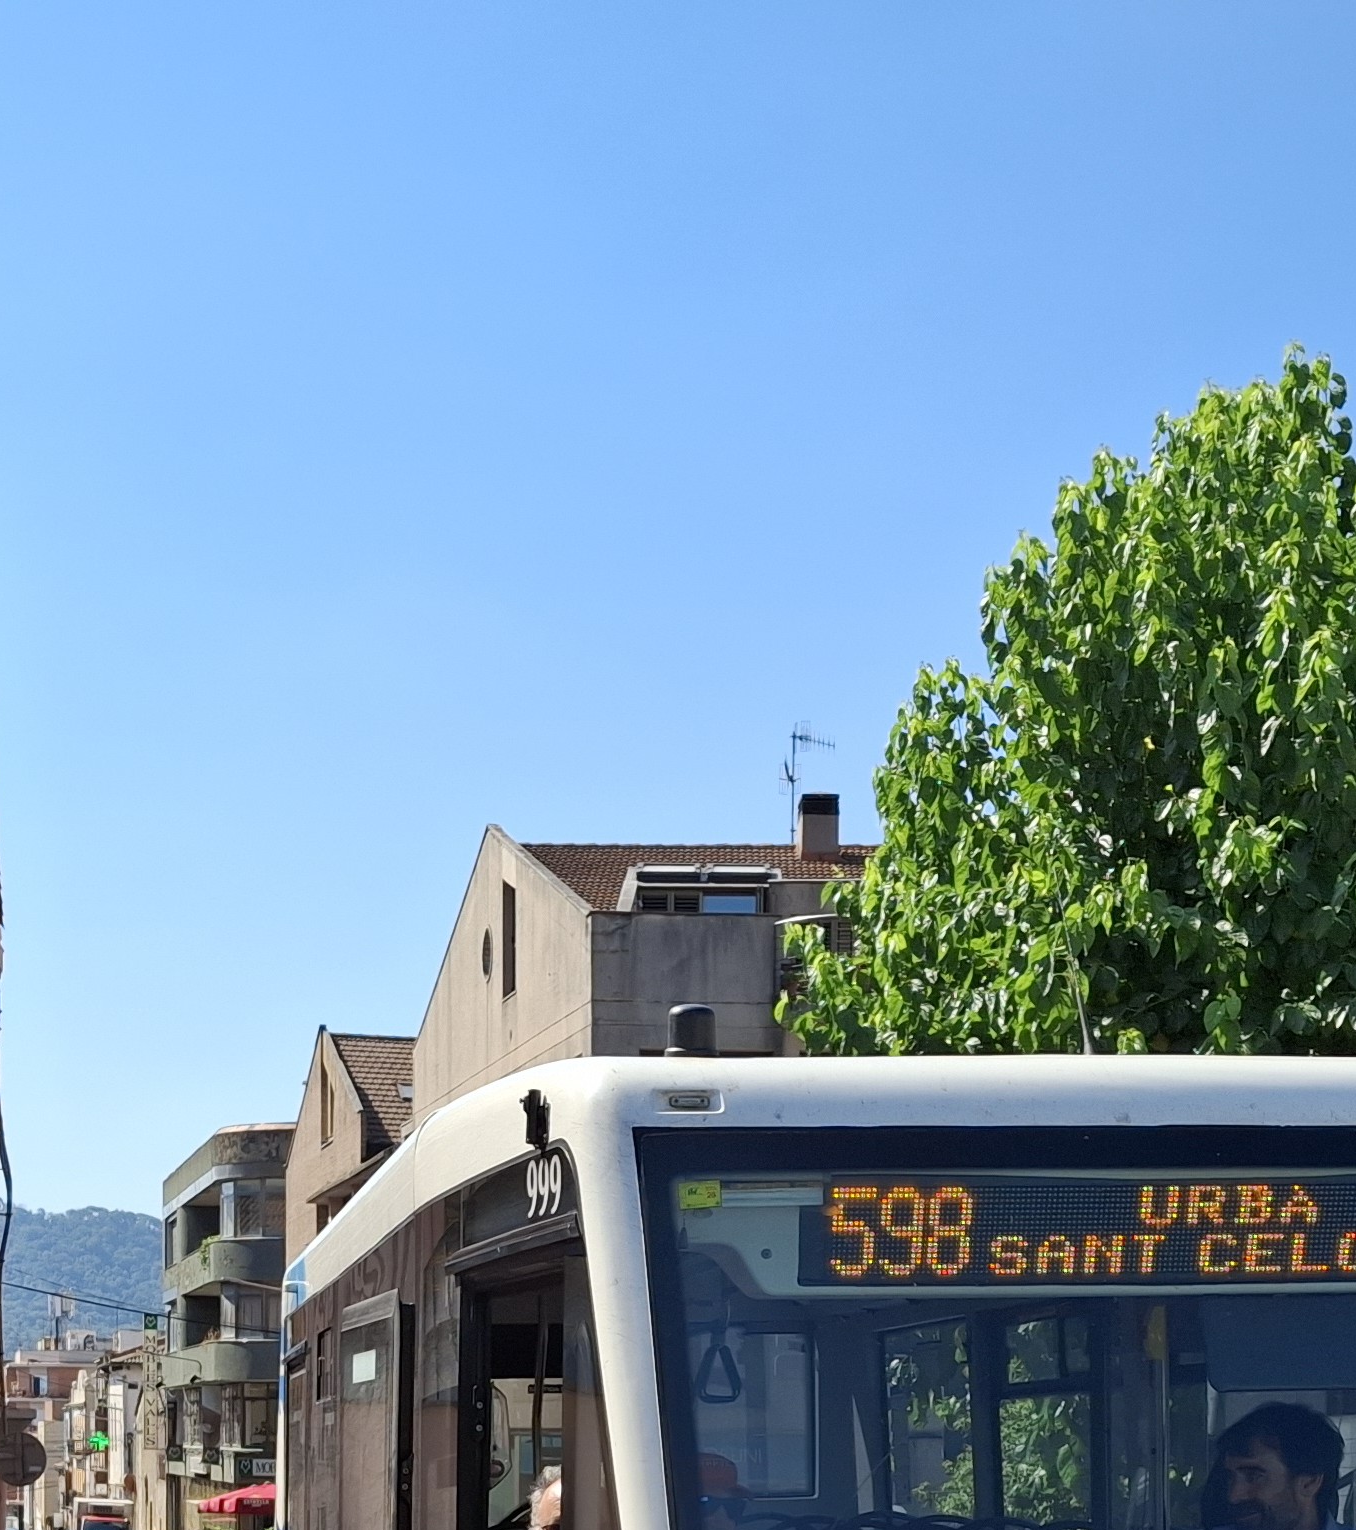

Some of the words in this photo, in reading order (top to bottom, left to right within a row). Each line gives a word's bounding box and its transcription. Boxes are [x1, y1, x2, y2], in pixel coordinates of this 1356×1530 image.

[526, 1154, 562, 1219] 999
[1138, 1184, 1319, 1225] URBA
[829, 1186, 974, 1275] 598
[989, 1234, 1165, 1275] SANT
